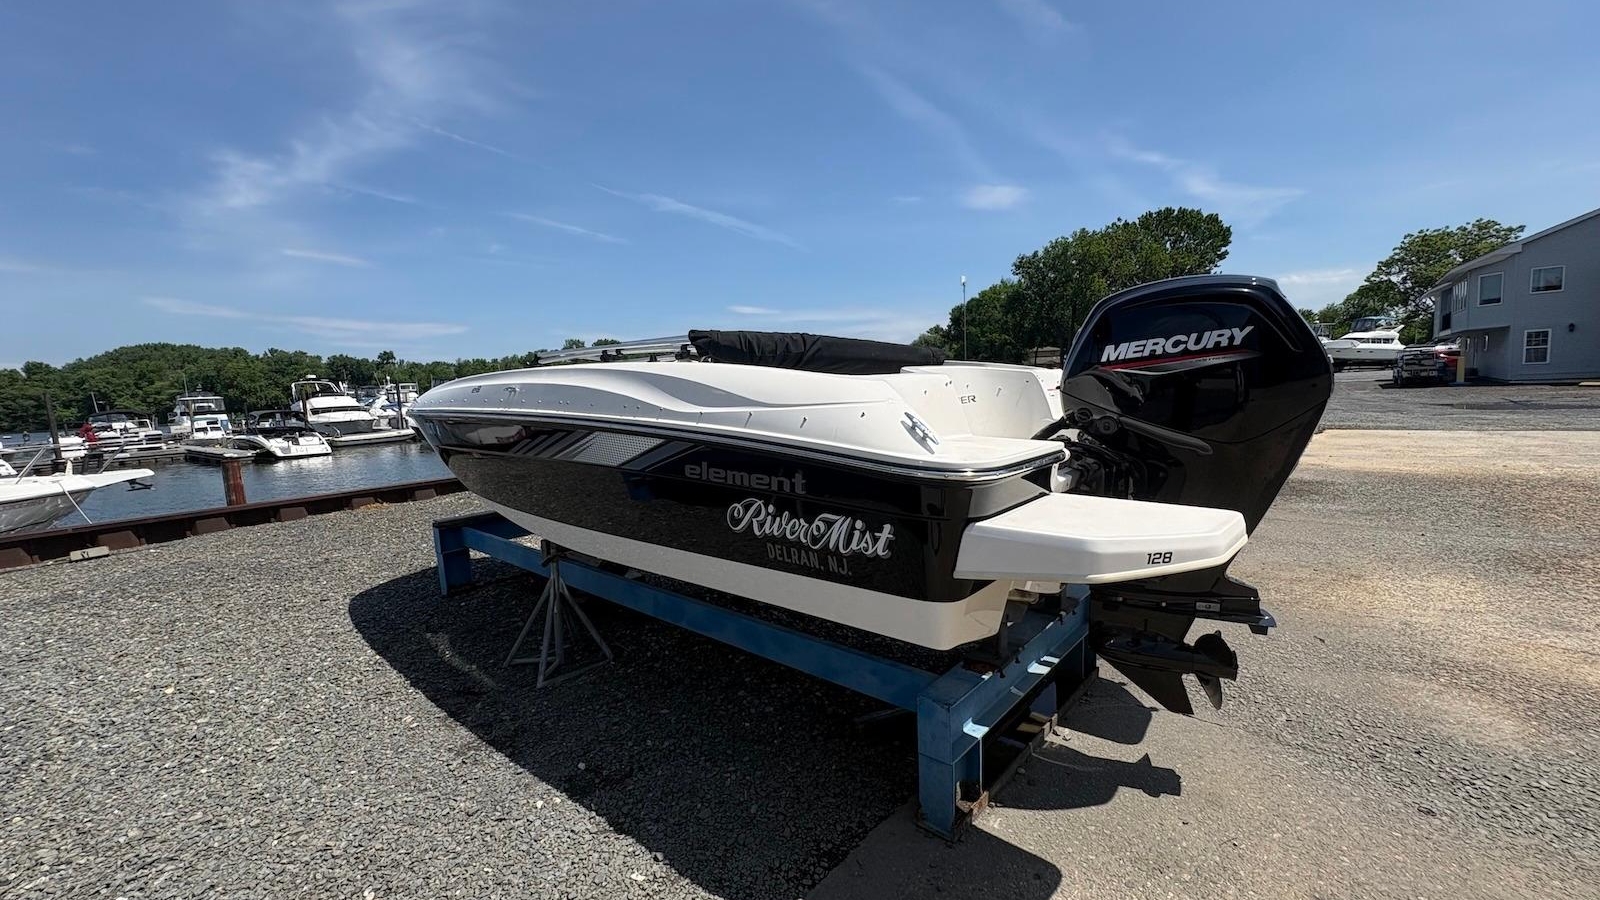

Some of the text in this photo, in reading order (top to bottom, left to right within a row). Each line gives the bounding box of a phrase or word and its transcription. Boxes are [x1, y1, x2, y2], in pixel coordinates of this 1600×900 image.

[1101, 325, 1254, 363] MERCURY
[684, 461, 807, 495] element
[1146, 552, 1173, 565] 128
